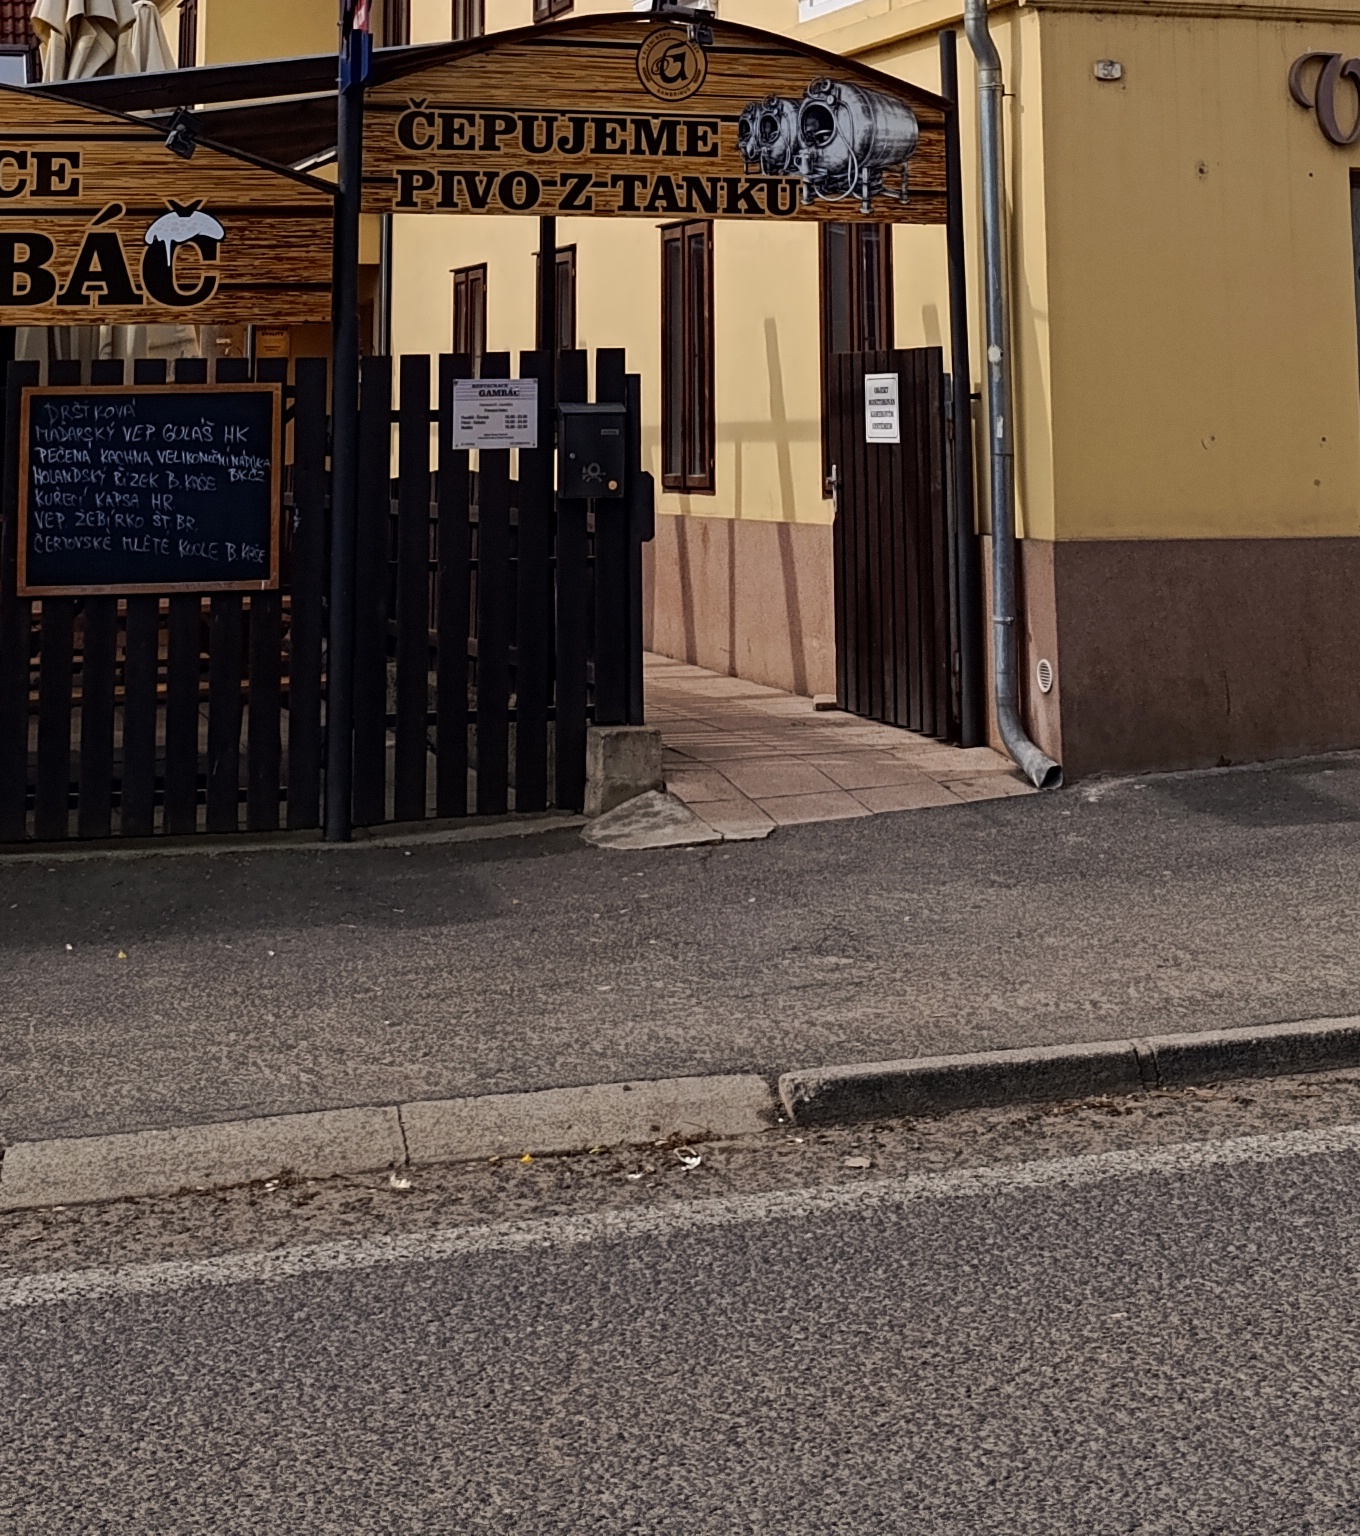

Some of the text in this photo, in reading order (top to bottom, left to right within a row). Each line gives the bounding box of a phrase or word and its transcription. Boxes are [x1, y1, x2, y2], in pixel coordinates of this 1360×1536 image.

[397, 96, 721, 159] ČEPUJEME
[395, 169, 801, 217] PIVO Z TANKU
[95, 491, 140, 508] KAPSA
